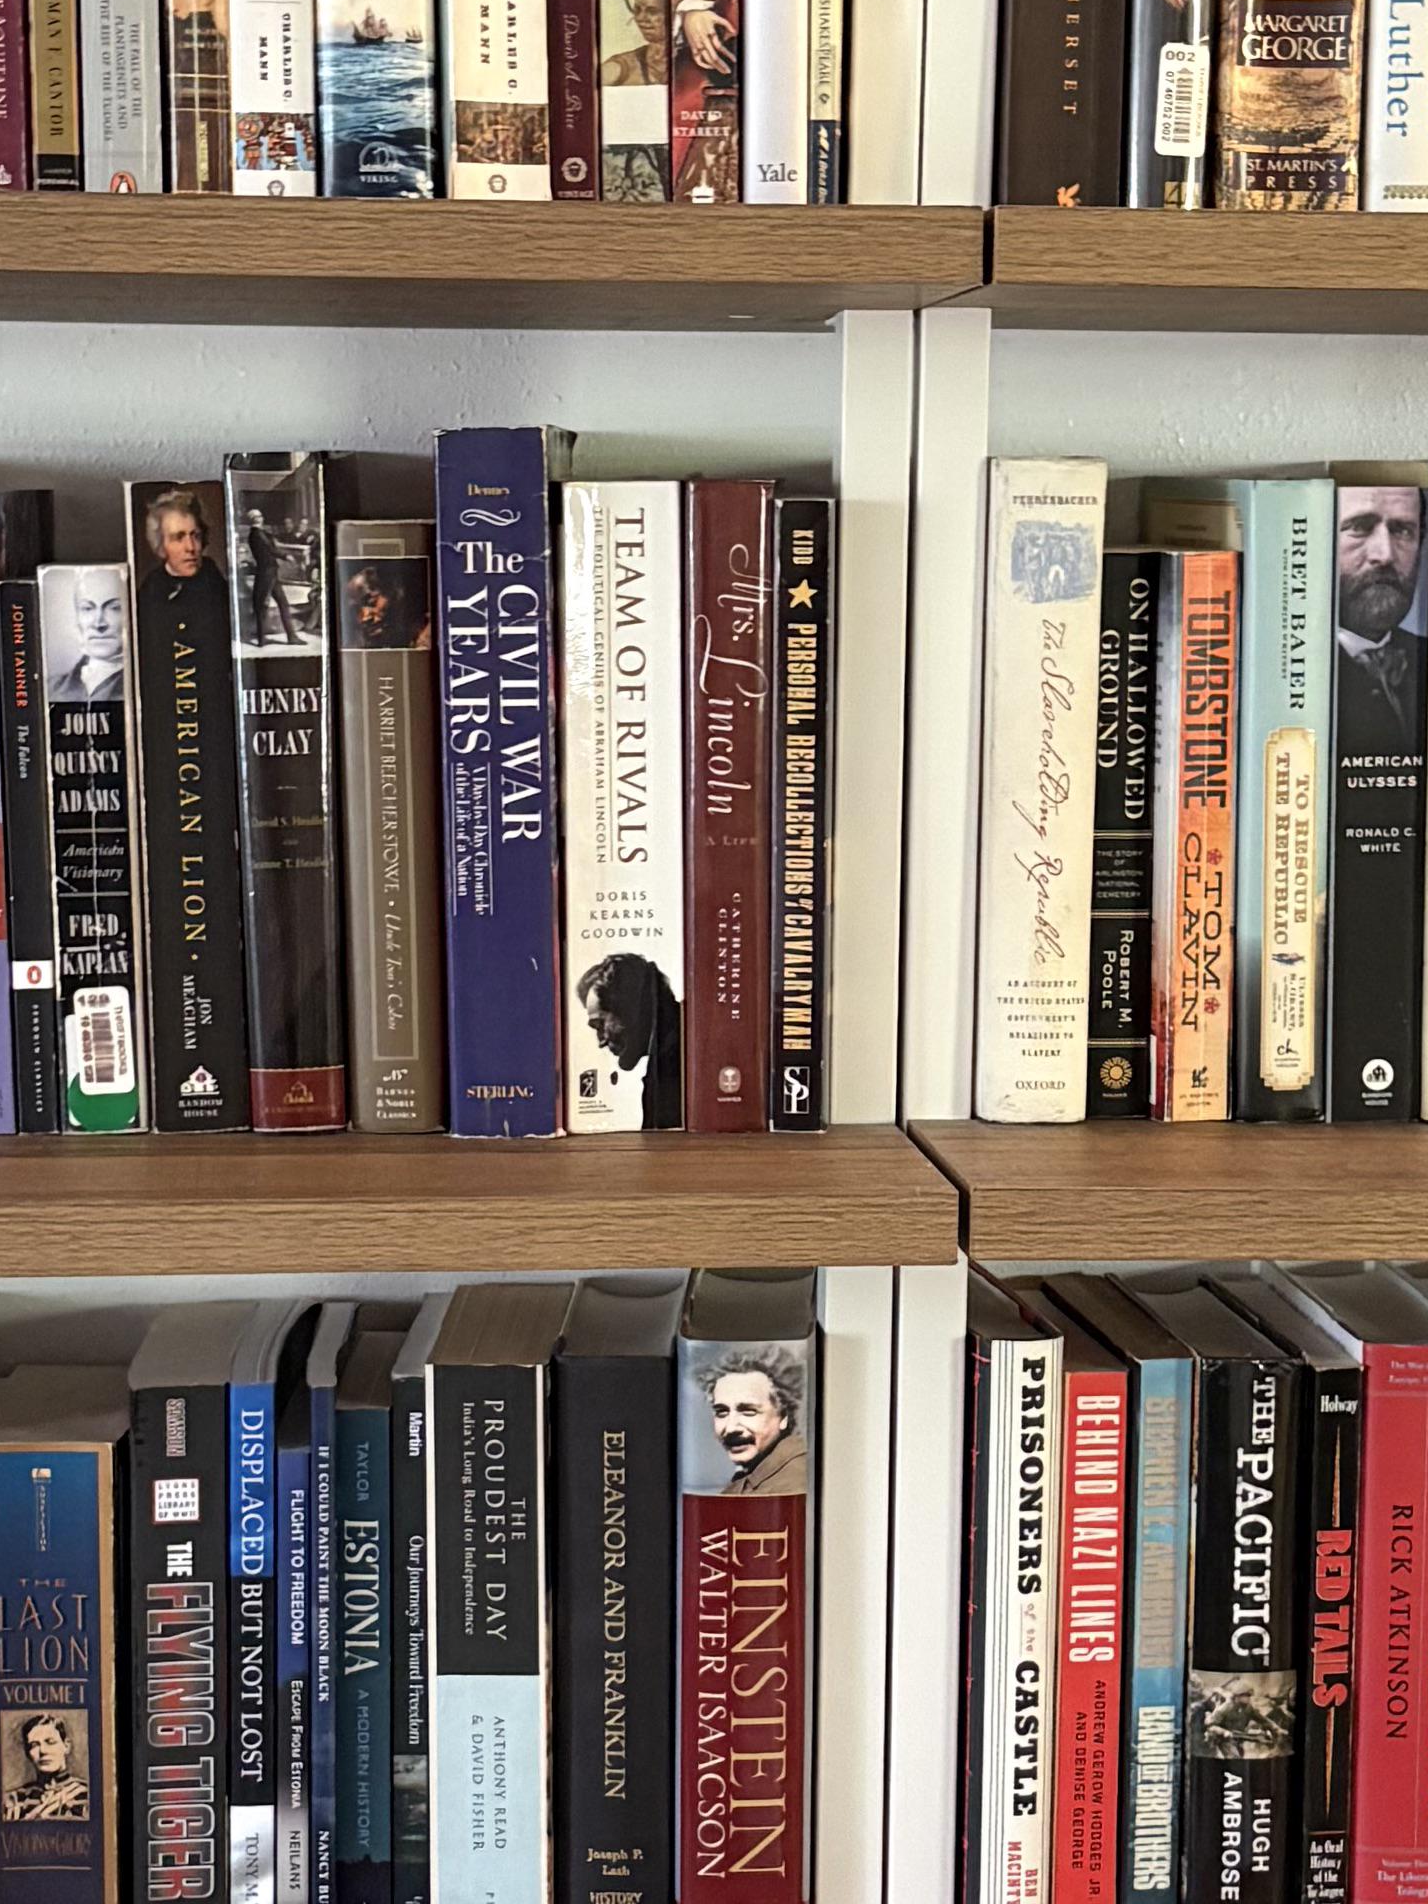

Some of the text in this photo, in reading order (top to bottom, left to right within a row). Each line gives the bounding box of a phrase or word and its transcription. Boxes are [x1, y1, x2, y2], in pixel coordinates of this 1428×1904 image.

[757, 162, 797, 186] Yale
[457, 541, 523, 575] The
[447, 594, 492, 756] YEARS
[242, 688, 321, 715] HENRY
[497, 583, 542, 844] CIVIL WAR
[1181, 591, 1232, 809] TOMBSTONE
[252, 729, 313, 757] CLAY
[1341, 756, 1423, 769] AMERICAN
[1346, 775, 1418, 788] ULYSSES
[595, 891, 646, 903] DORIS
[590, 909, 654, 921] KEARNS
[580, 926, 663, 939] GOODWIN
[466, 1084, 534, 1100] STERLING
[1068, 1395, 1121, 1664] BEHIND NAZI LINES
[345, 1519, 379, 1675] ESTONIA
[731, 1526, 788, 1878] EINSTEIN
